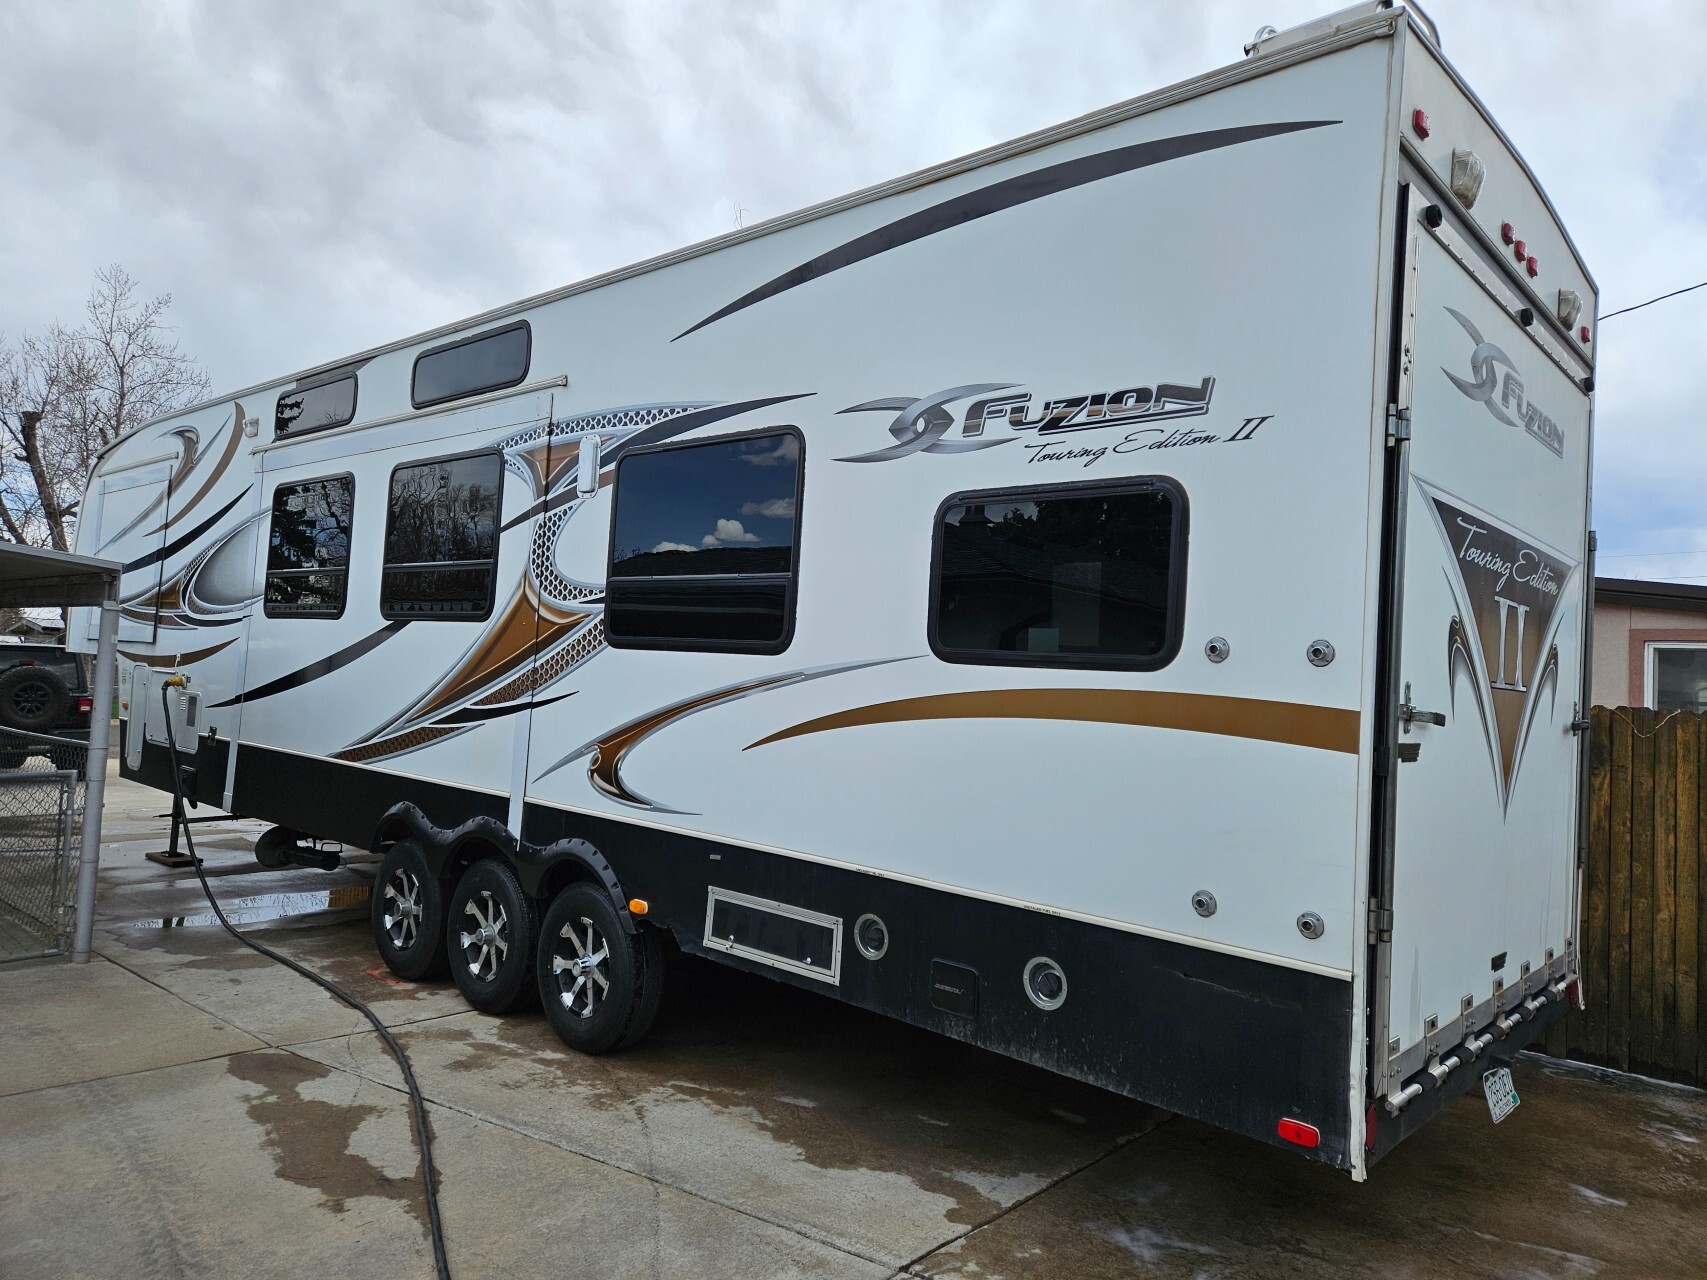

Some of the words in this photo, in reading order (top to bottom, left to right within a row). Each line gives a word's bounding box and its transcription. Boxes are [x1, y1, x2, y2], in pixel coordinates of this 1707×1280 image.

[962, 375, 1216, 437] FUZION
[1024, 441, 1108, 468] Touring
[1113, 428, 1221, 454] Edition
[1223, 414, 1276, 443] II
[1502, 370, 1565, 460] FUZION
[1456, 516, 1511, 592] Touring
[1512, 549, 1559, 596] Edition
[1491, 595, 1530, 692] II
